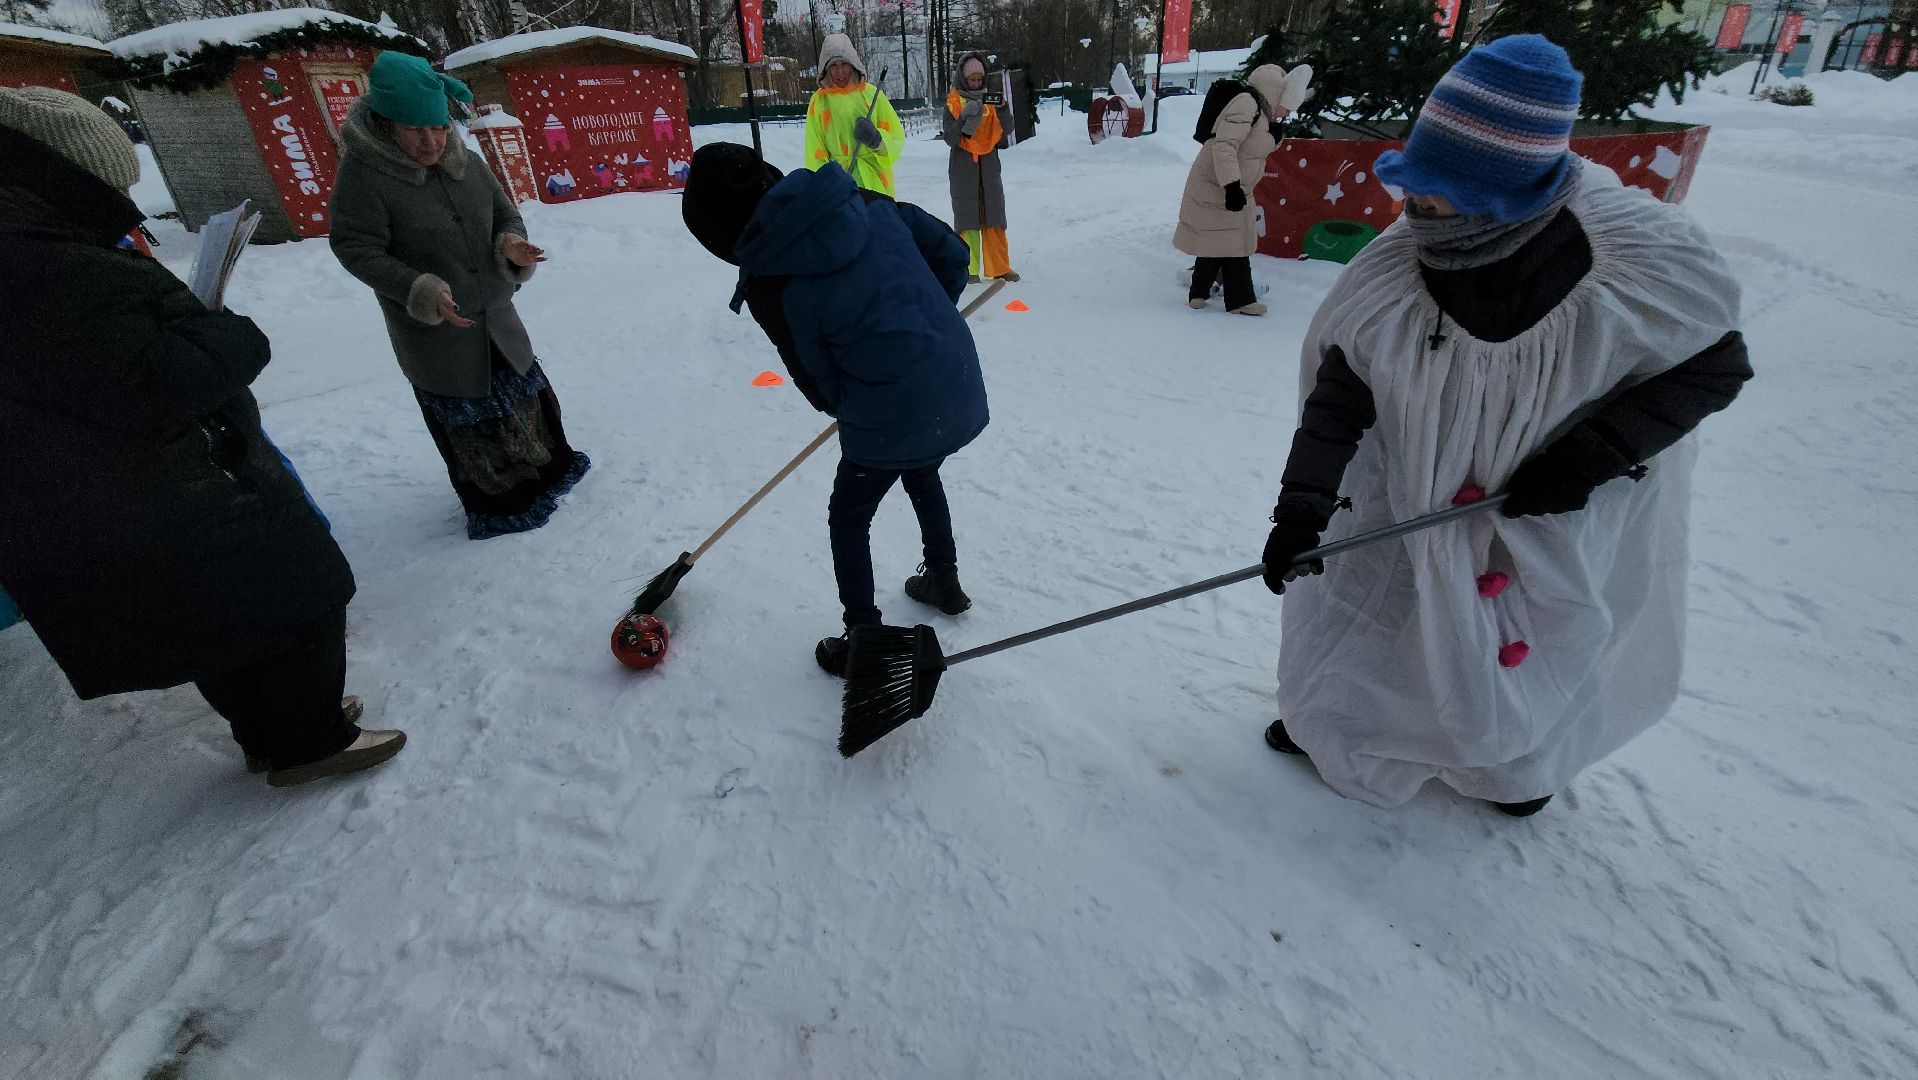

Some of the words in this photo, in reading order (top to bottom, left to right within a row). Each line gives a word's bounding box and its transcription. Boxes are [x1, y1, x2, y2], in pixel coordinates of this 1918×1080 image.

[572, 111, 645, 130] НОВОГОДНЕЕ
[588, 128, 639, 146] КАРАОКЕ
[273, 114, 320, 196] ЗИМА
